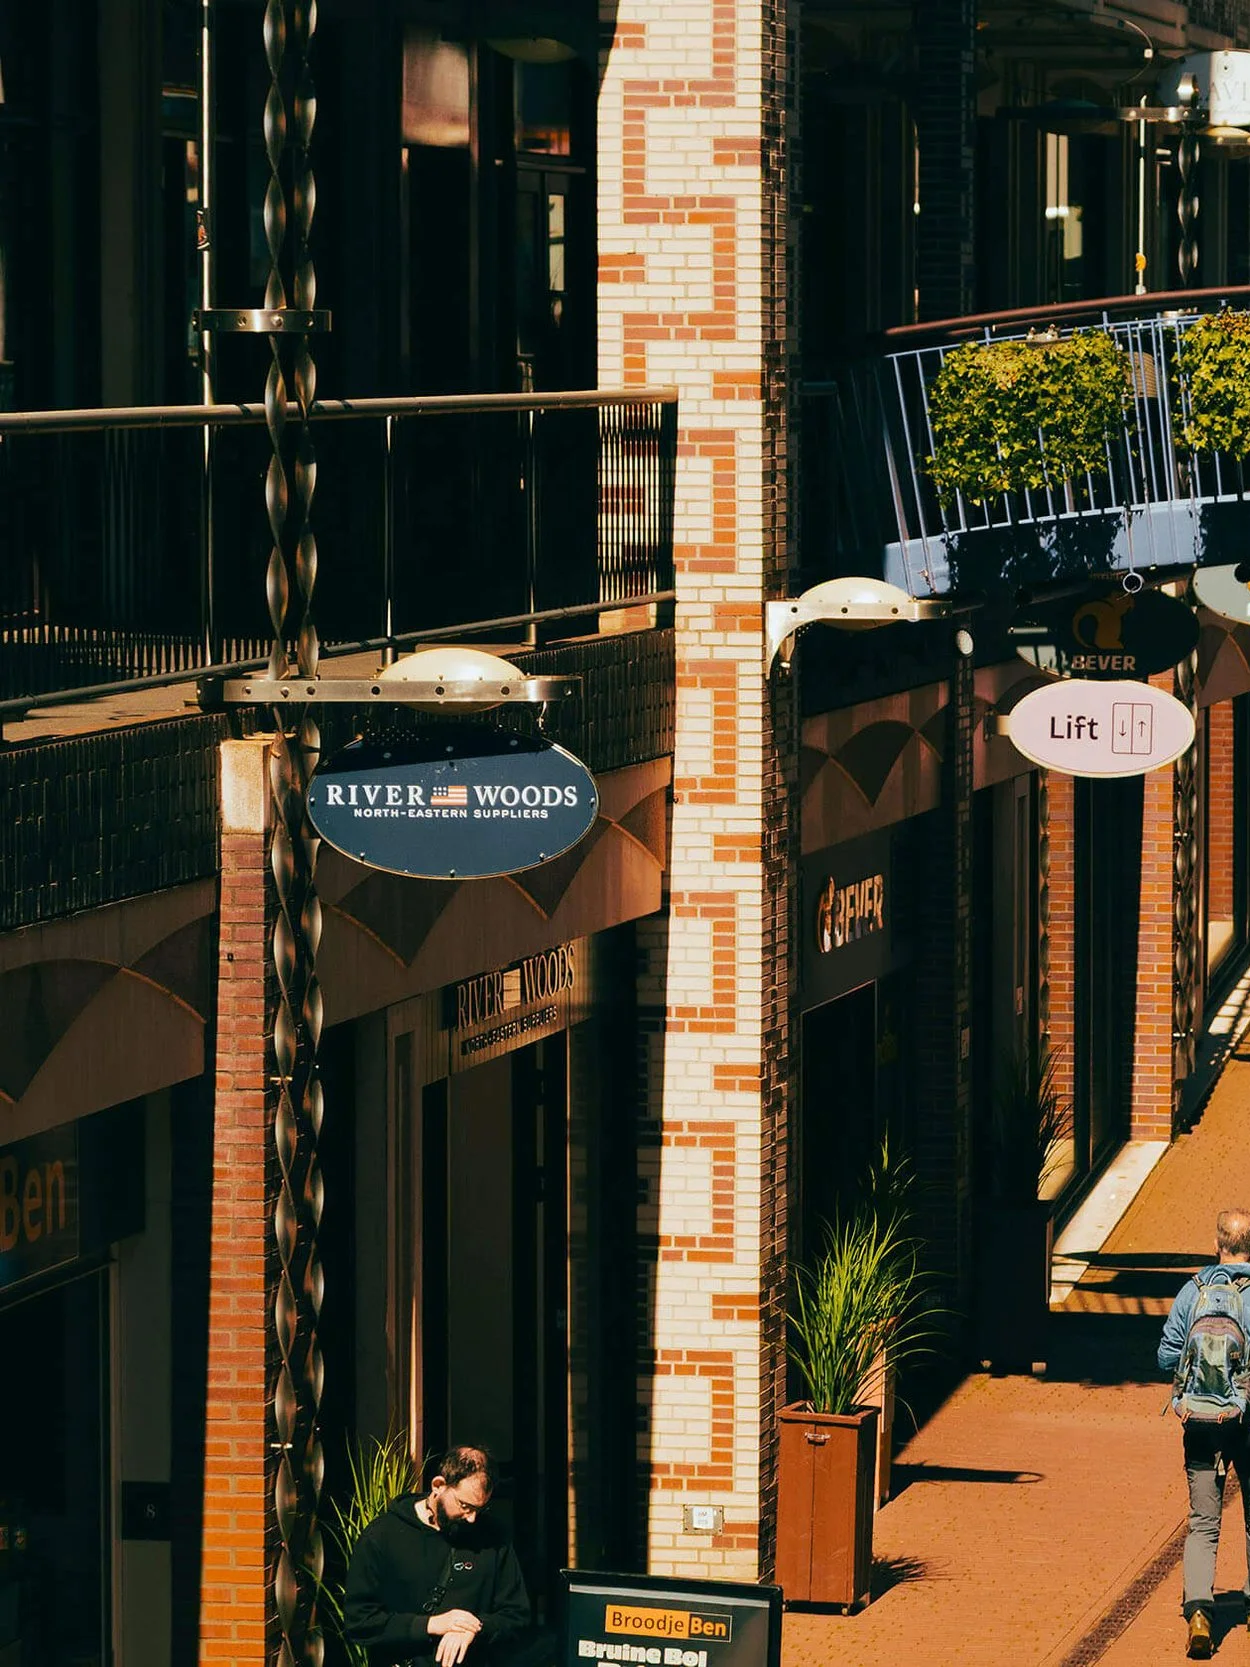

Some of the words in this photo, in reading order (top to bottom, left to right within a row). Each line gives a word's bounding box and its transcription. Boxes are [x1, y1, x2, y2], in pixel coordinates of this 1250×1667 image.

[1072, 655, 1136, 671] BEVER
[1050, 715, 1099, 740] Lift
[326, 785, 426, 806] RIVER
[473, 785, 578, 807] WOODS
[353, 808, 467, 818] NORTH-EASTERN
[473, 809, 549, 819] SUPPLIERS
[834, 874, 884, 947] BEVER
[456, 971, 505, 1032] RIVER
[522, 944, 575, 1004] WOODS
[612, 1611, 684, 1635] Broodje
[689, 1617, 727, 1637] Ben
[578, 1640, 661, 1664] Bruine
